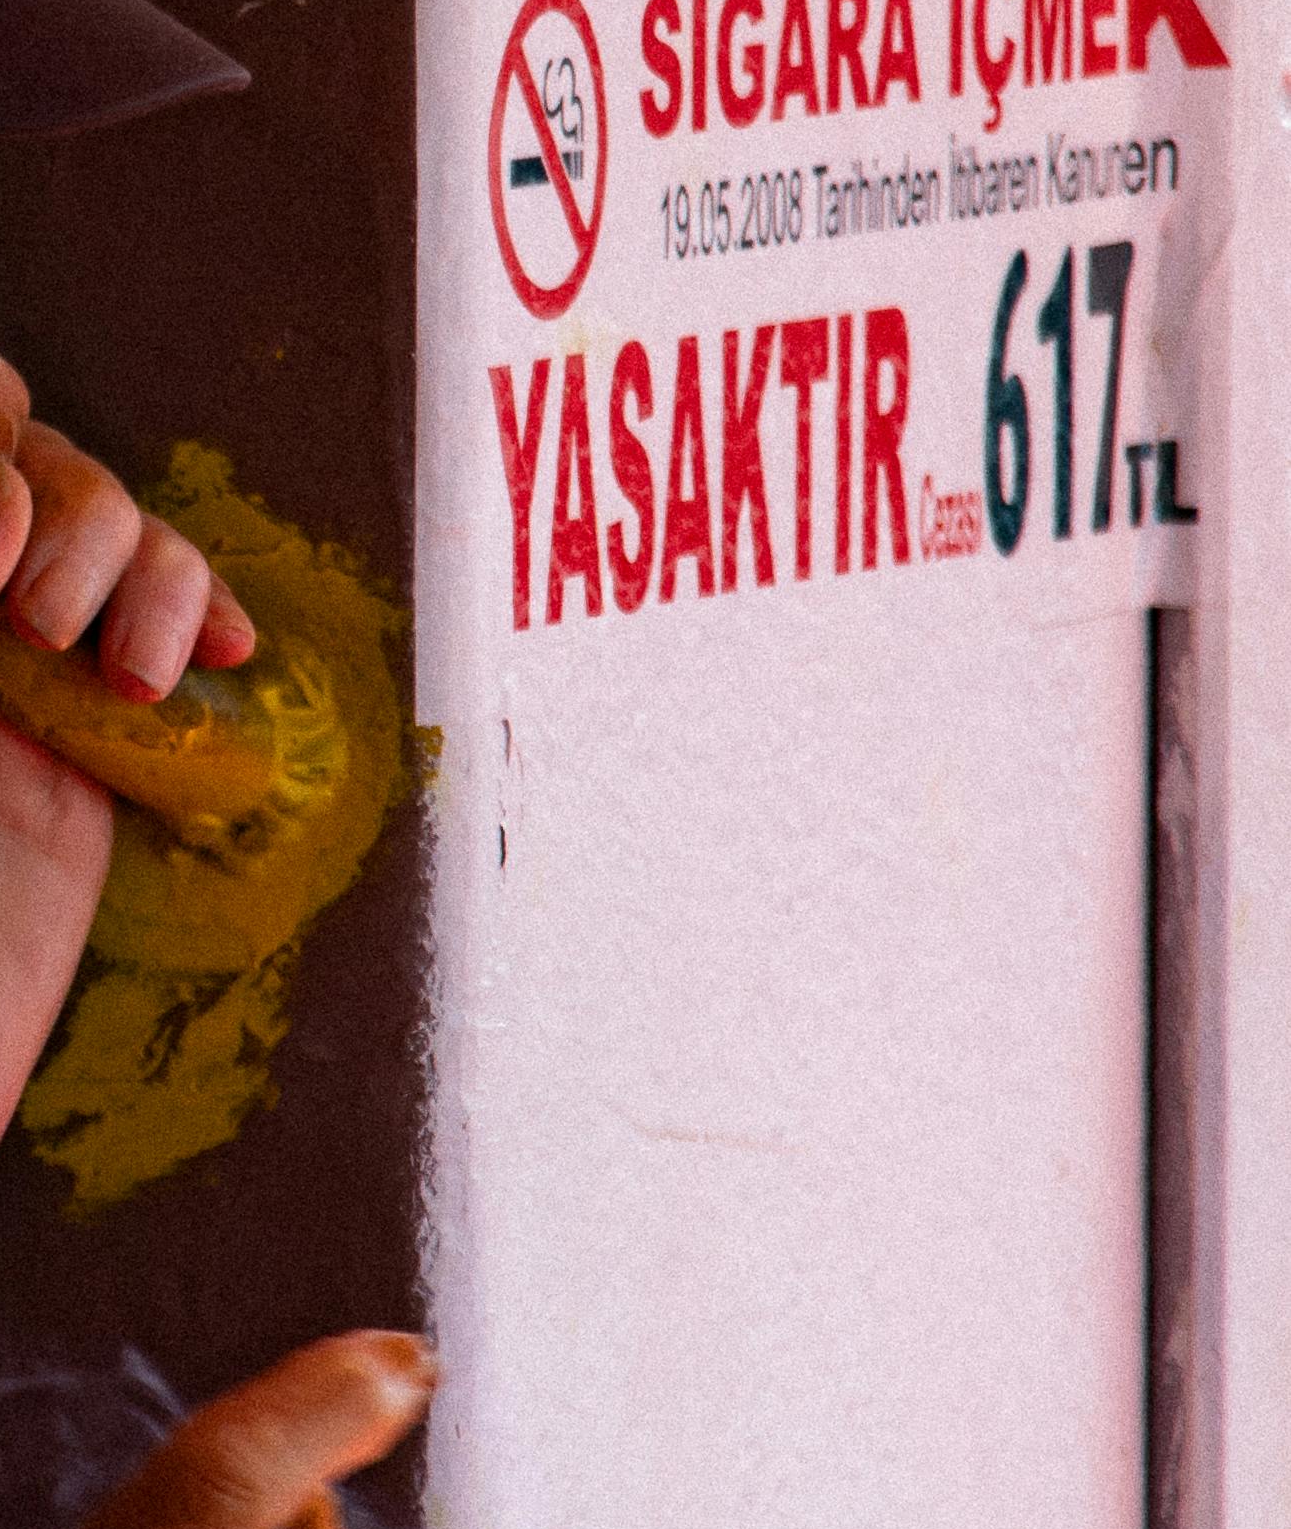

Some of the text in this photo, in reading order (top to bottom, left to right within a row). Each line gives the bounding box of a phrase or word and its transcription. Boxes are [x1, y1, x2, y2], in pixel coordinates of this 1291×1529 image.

[660, 167, 804, 260] 19.05.2008
[811, 155, 941, 240] Tarihinden
[1046, 133, 1181, 205] Kanunen
[488, 307, 912, 631] YASAKTIR
[985, 241, 1135, 557] 617
[1125, 440, 1198, 529] TL
